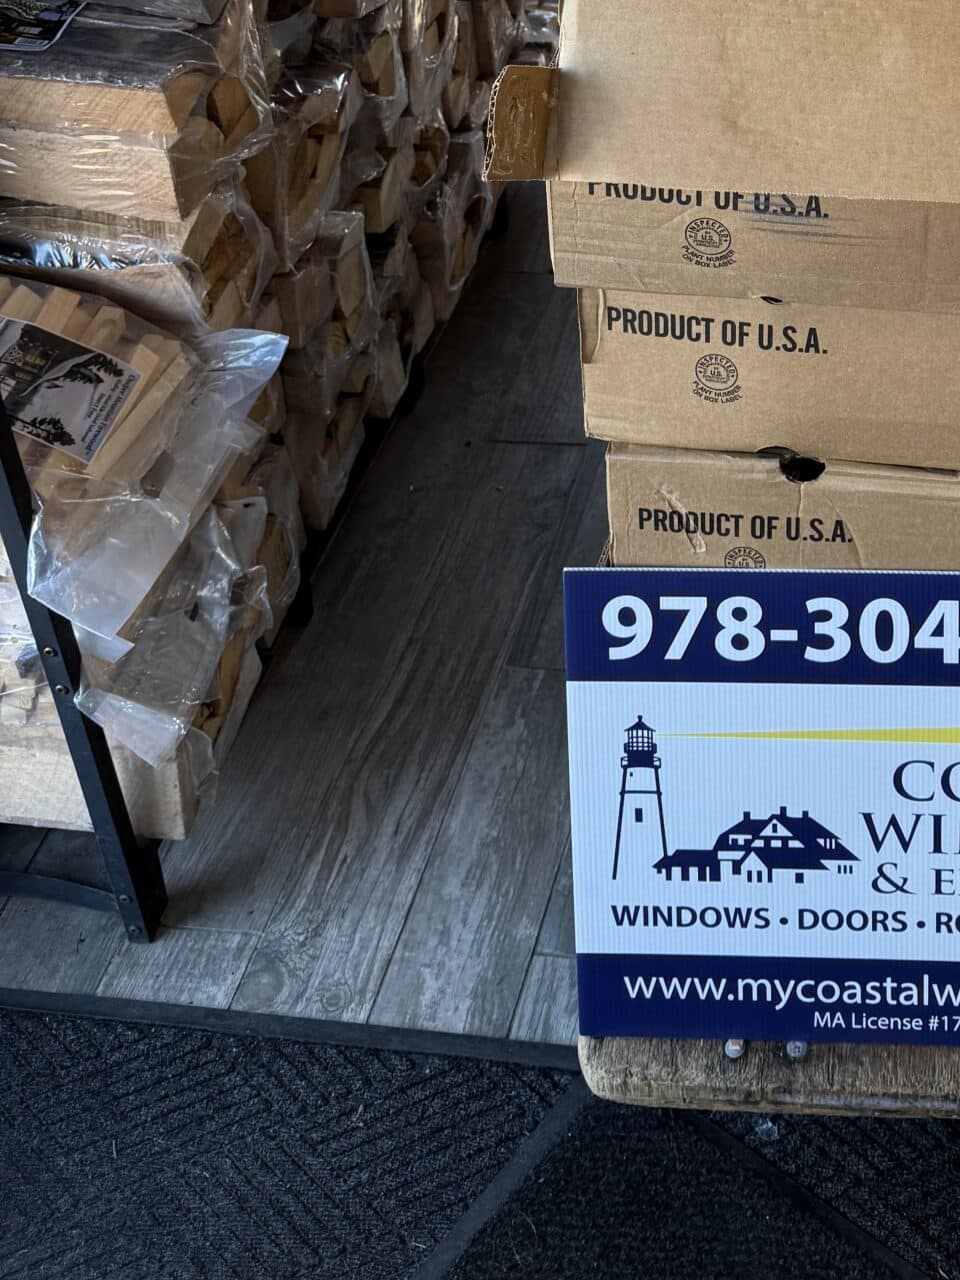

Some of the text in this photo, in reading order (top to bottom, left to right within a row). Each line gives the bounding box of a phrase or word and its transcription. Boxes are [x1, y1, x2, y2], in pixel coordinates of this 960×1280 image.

[754, 192, 829, 219] U.S.A.
[688, 220, 729, 238] INSPECTED
[682, 245, 735, 262] PLANT NUMBER
[682, 253, 736, 268] ON BOX LABEL
[607, 306, 828, 354] PRODUCT OF U.S.A.
[698, 356, 735, 373] INSPECTED
[693, 380, 742, 397] PLANT NUMBER
[693, 389, 743, 403] ON BOX LABEL
[638, 507, 853, 543] PRODUCT OF U.S.A.
[871, 861, 910, 895] &
[611, 904, 771, 930] WINDOWS
[798, 908, 908, 934] DOORS
[813, 1011, 846, 1030] MA
[851, 1012, 922, 1032] License
